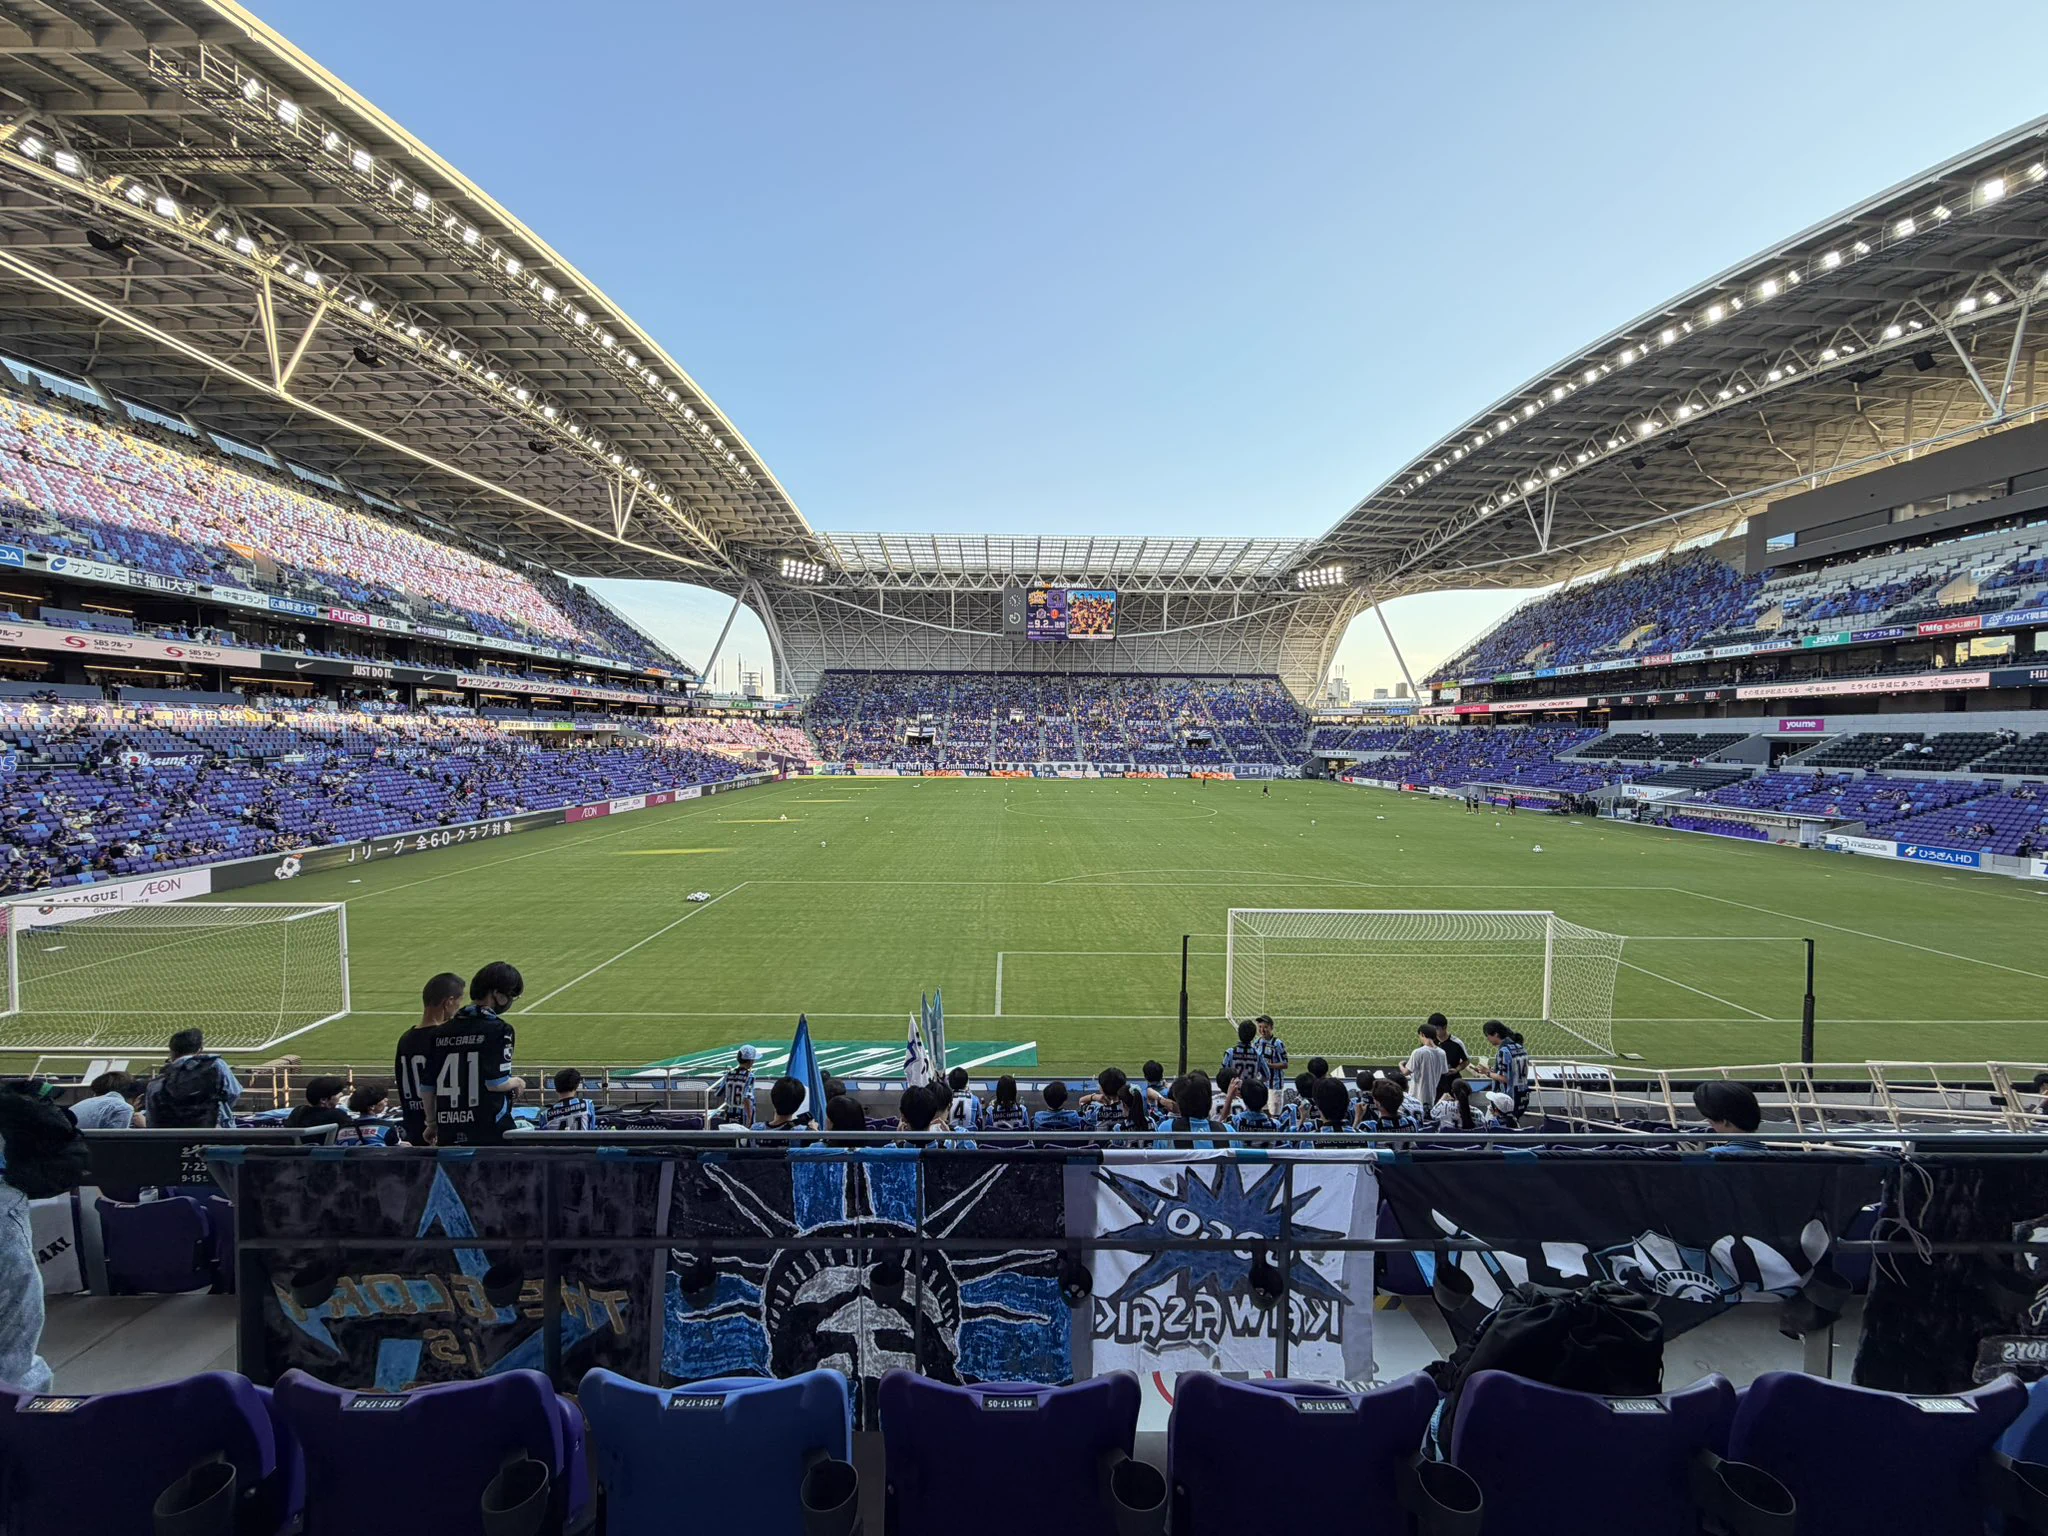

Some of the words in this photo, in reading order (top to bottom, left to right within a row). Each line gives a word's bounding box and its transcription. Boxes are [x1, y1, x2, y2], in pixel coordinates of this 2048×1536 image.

[69, 561, 127, 583] サンセルモ
[144, 574, 196, 595] 福山大学
[223, 590, 268, 609] 中電プラント
[93, 639, 109, 647] SBS
[1812, 633, 1840, 645] JSW
[188, 649, 202, 657] SBS
[352, 665, 371, 677] JUST
[372, 667, 384, 678] DO
[384, 668, 394, 679] IT.
[1785, 720, 1817, 730] youme
[347, 838, 405, 863] Jリーグ
[1850, 840, 1888, 852] mazda
[436, 1051, 480, 1109] 41
[437, 1110, 475, 1125] IENAGA
[952, 1105, 966, 1123] 4
[181, 1162, 208, 1172] 7-23
